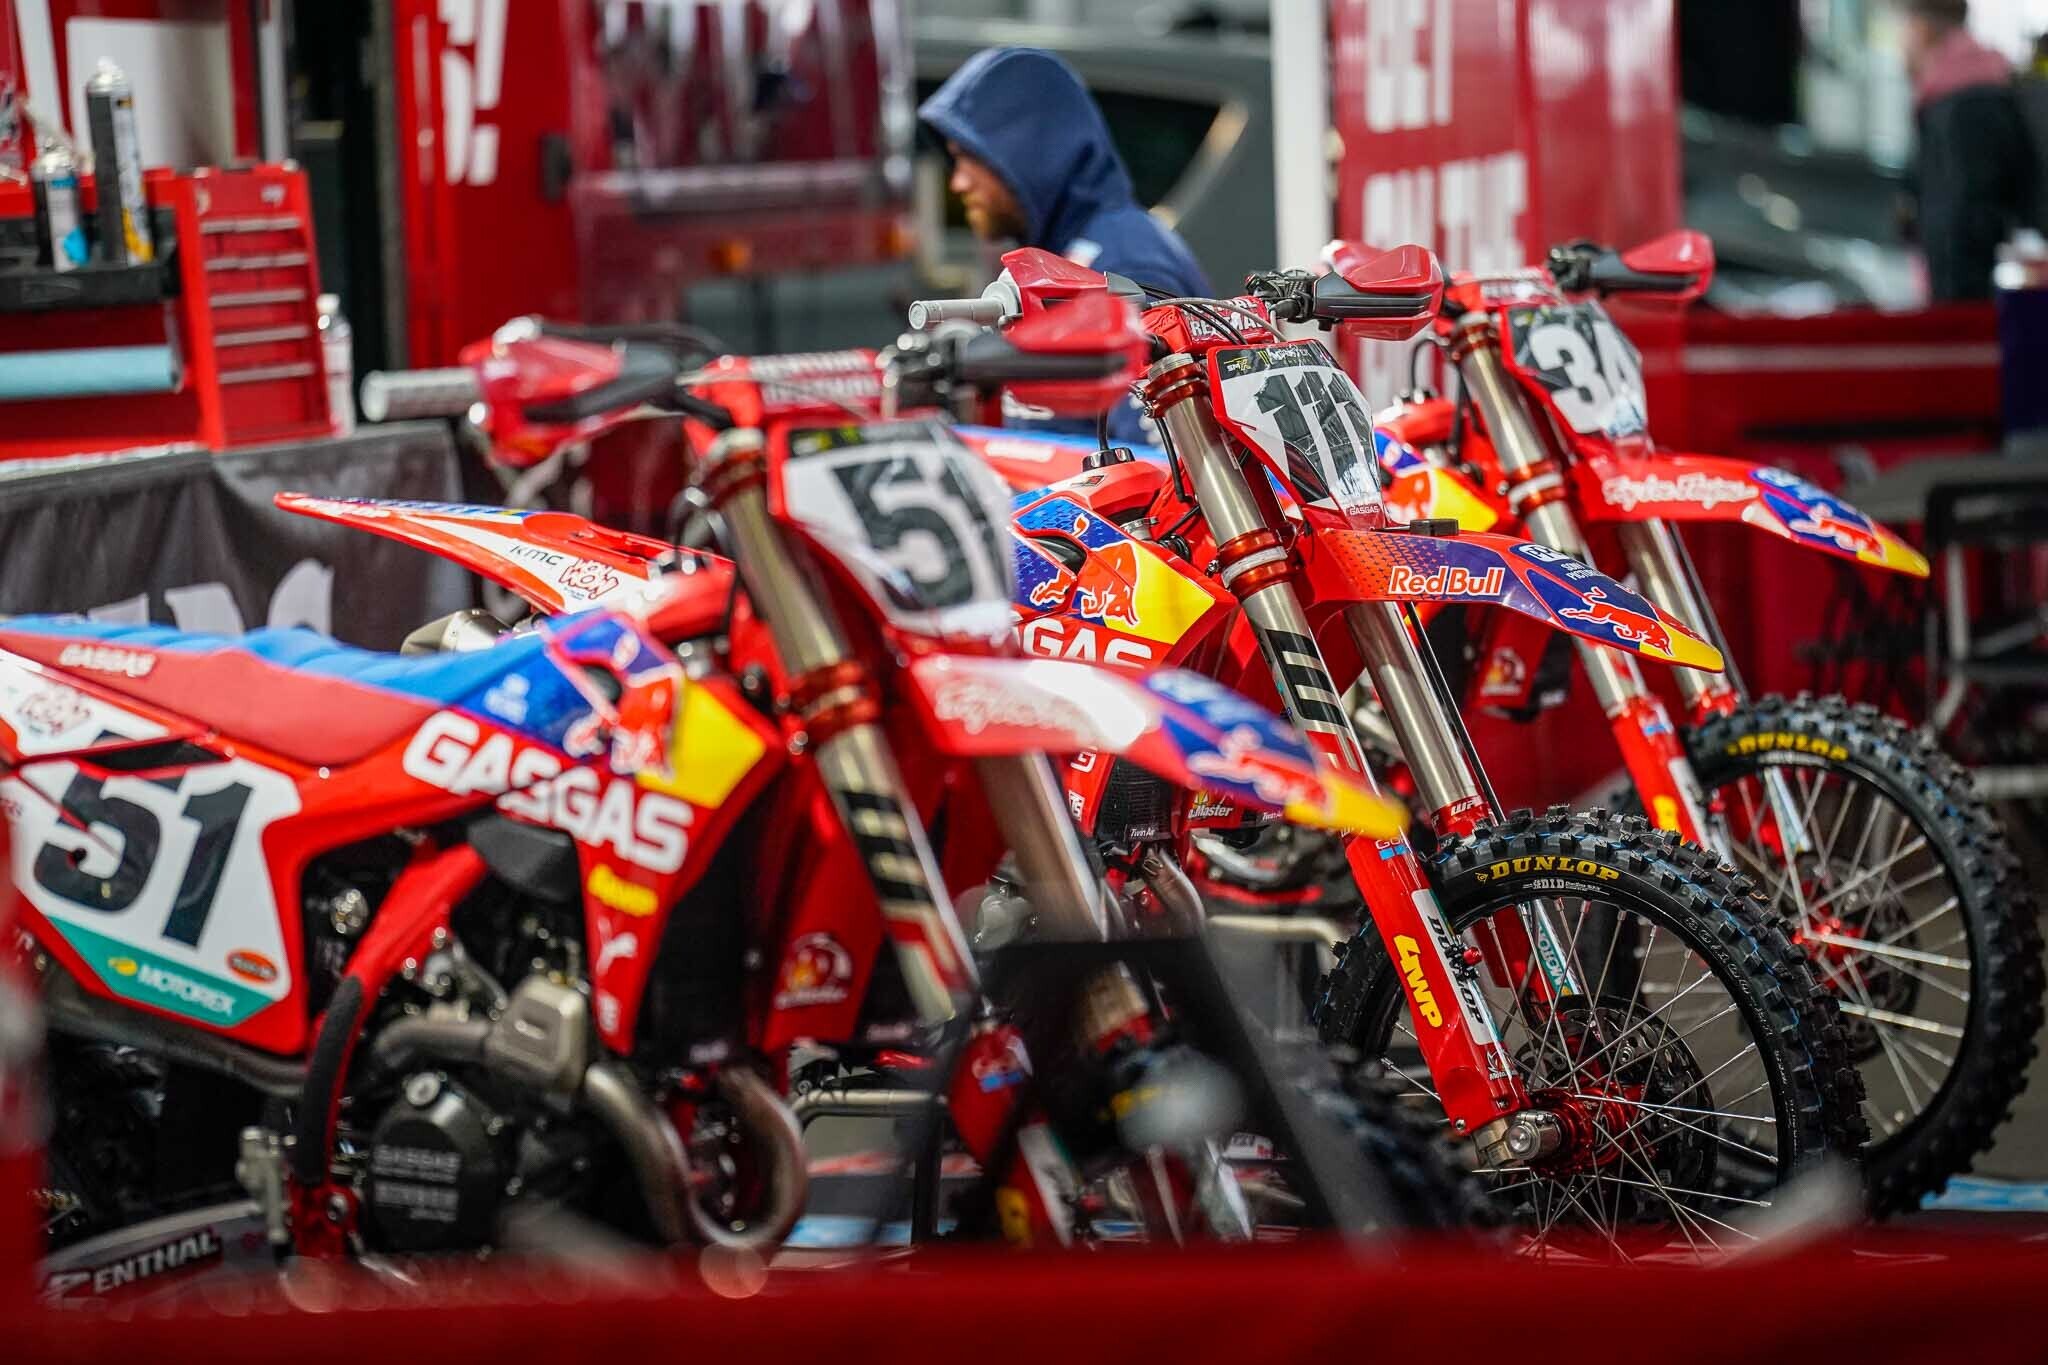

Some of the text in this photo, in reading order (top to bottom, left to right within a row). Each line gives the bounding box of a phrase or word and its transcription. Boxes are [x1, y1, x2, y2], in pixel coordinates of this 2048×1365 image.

[1254, 371, 1379, 501] 111
[1528, 320, 1645, 434] 34
[1388, 566, 1505, 596] Red Bull
[34, 732, 253, 949] 51
[402, 709, 694, 874] GASGAS
[1490, 856, 1620, 881] DUNLOP
